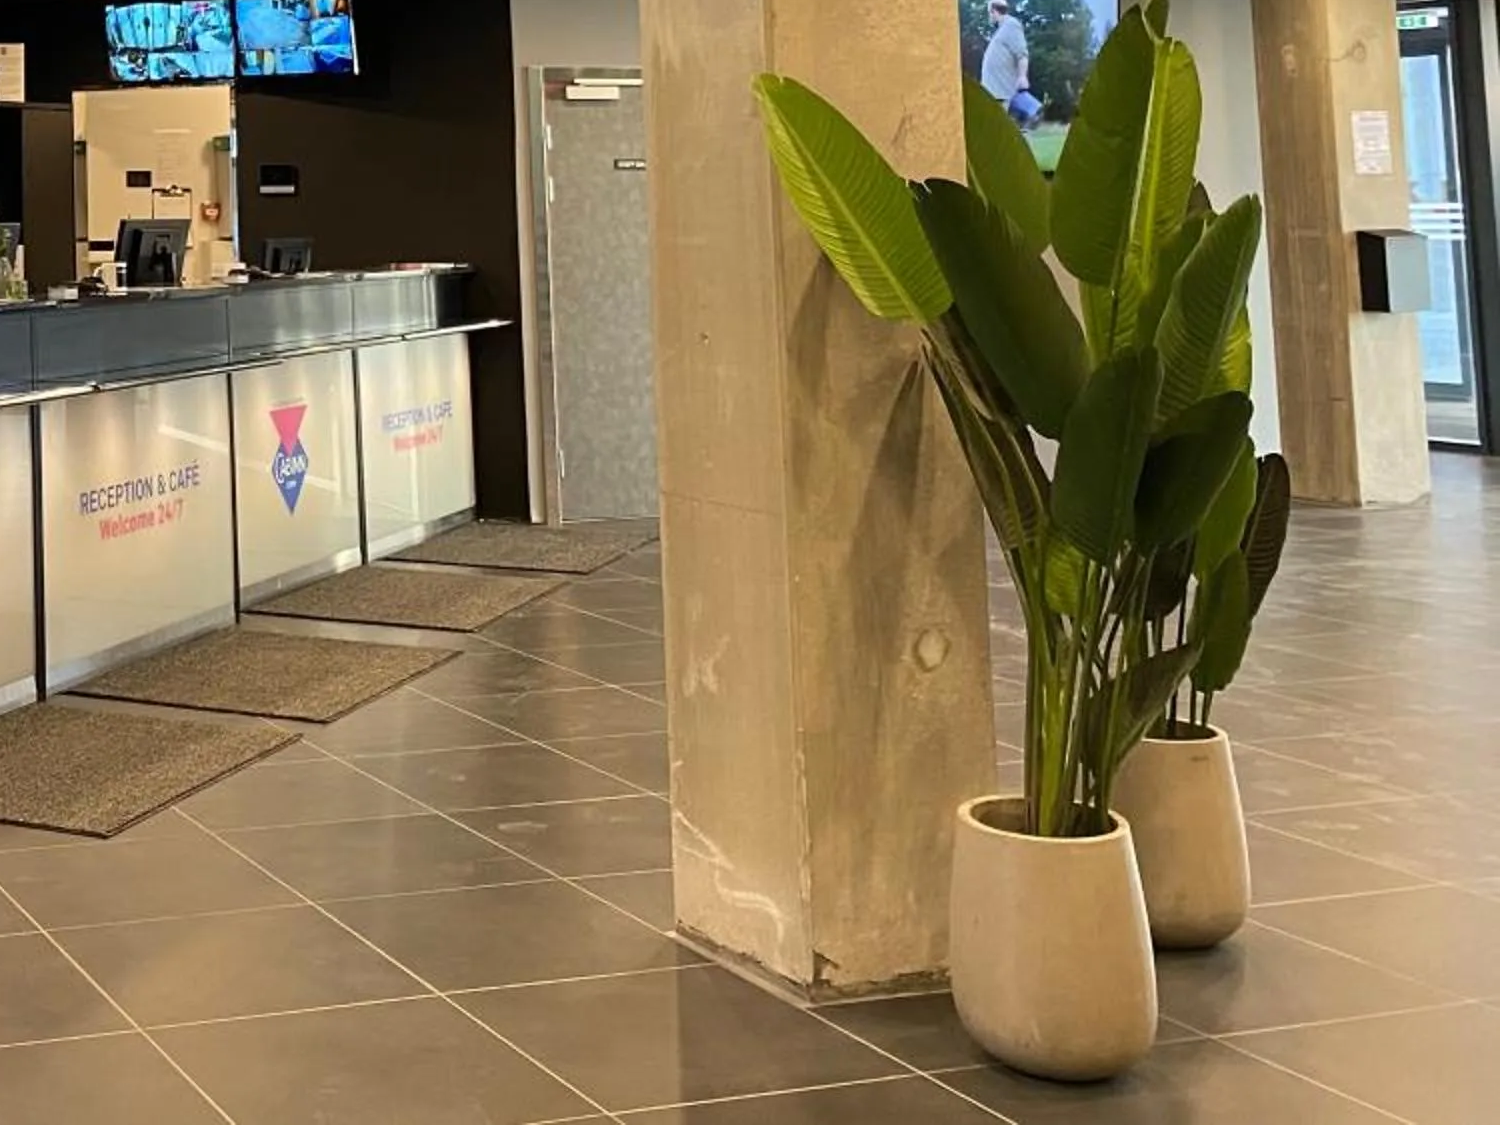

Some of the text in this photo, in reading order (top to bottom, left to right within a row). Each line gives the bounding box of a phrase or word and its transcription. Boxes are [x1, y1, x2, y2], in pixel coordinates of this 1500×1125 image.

[79, 459, 200, 515] RECEPTION & CAFÉ
[99, 510, 155, 540] Welcome
